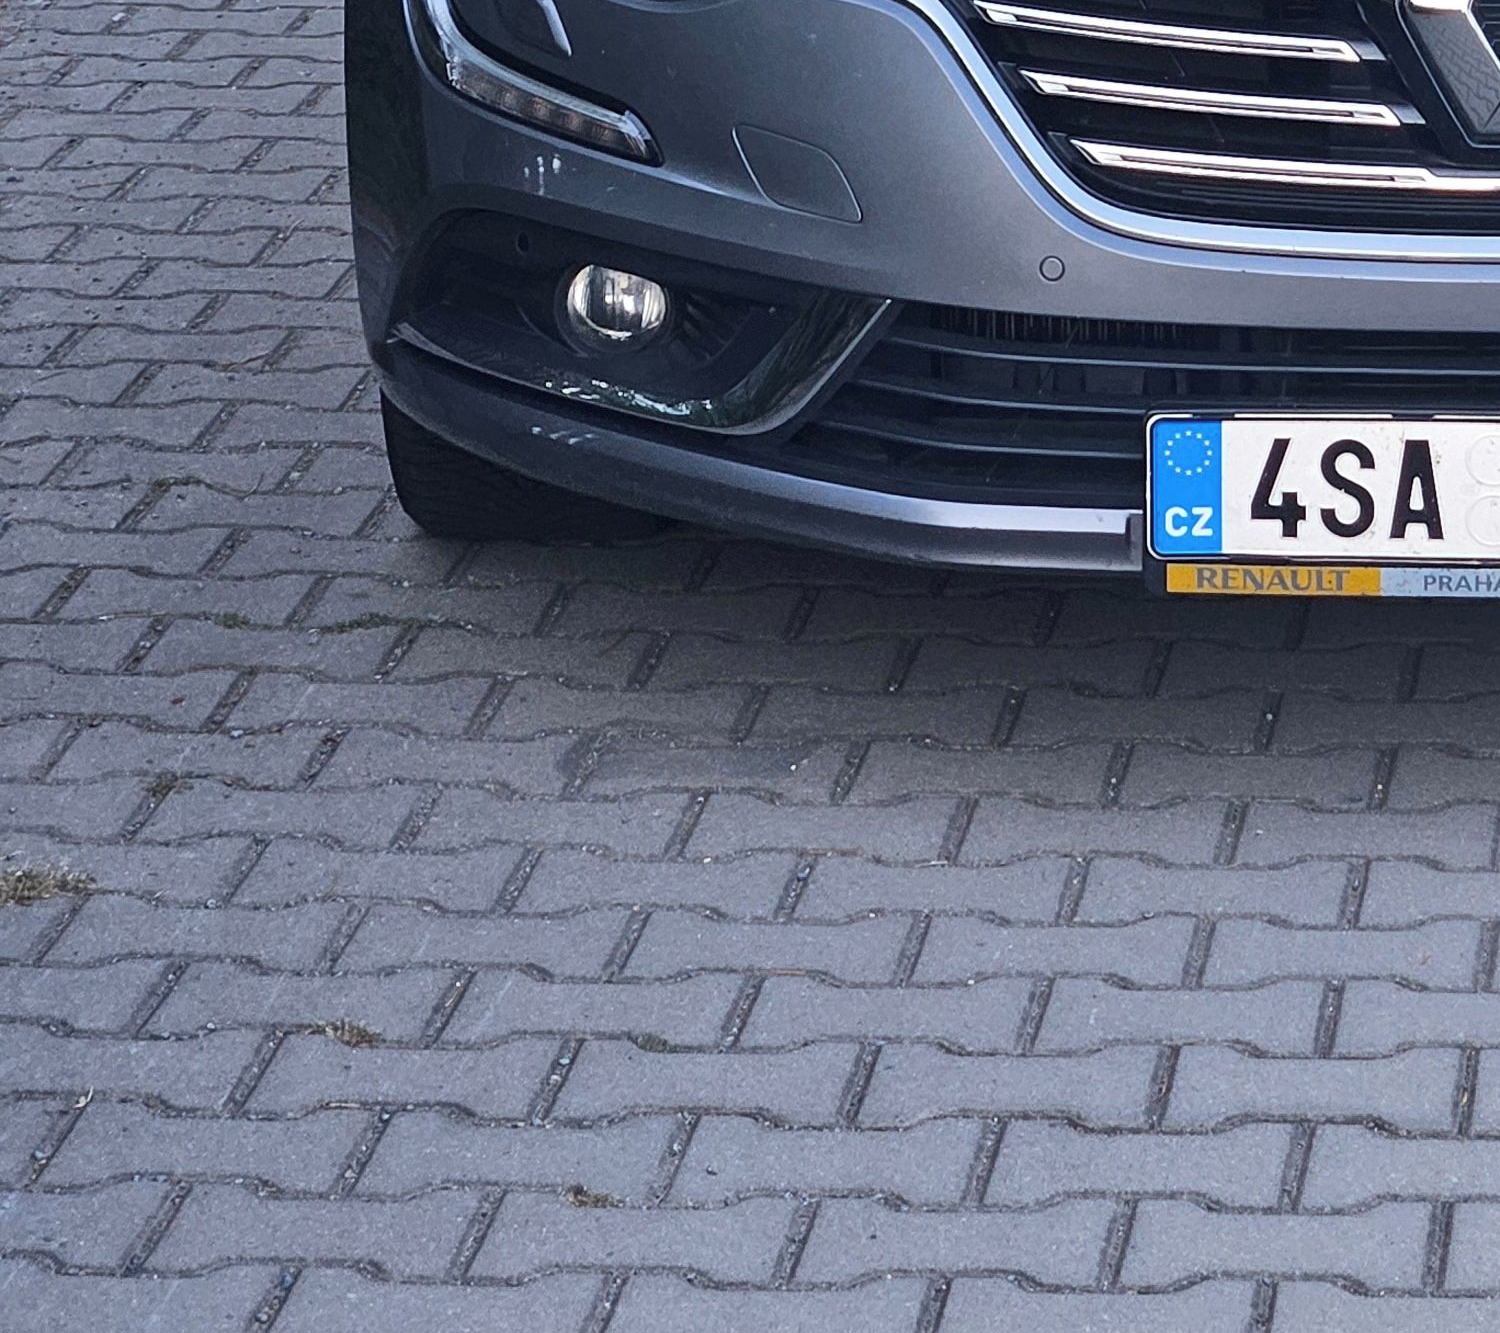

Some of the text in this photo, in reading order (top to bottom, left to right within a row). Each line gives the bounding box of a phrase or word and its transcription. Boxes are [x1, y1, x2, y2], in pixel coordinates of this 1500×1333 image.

[1250, 437, 1445, 541] 4SA
[1165, 505, 1214, 538] CZ
[1196, 567, 1350, 592] RENAULT
